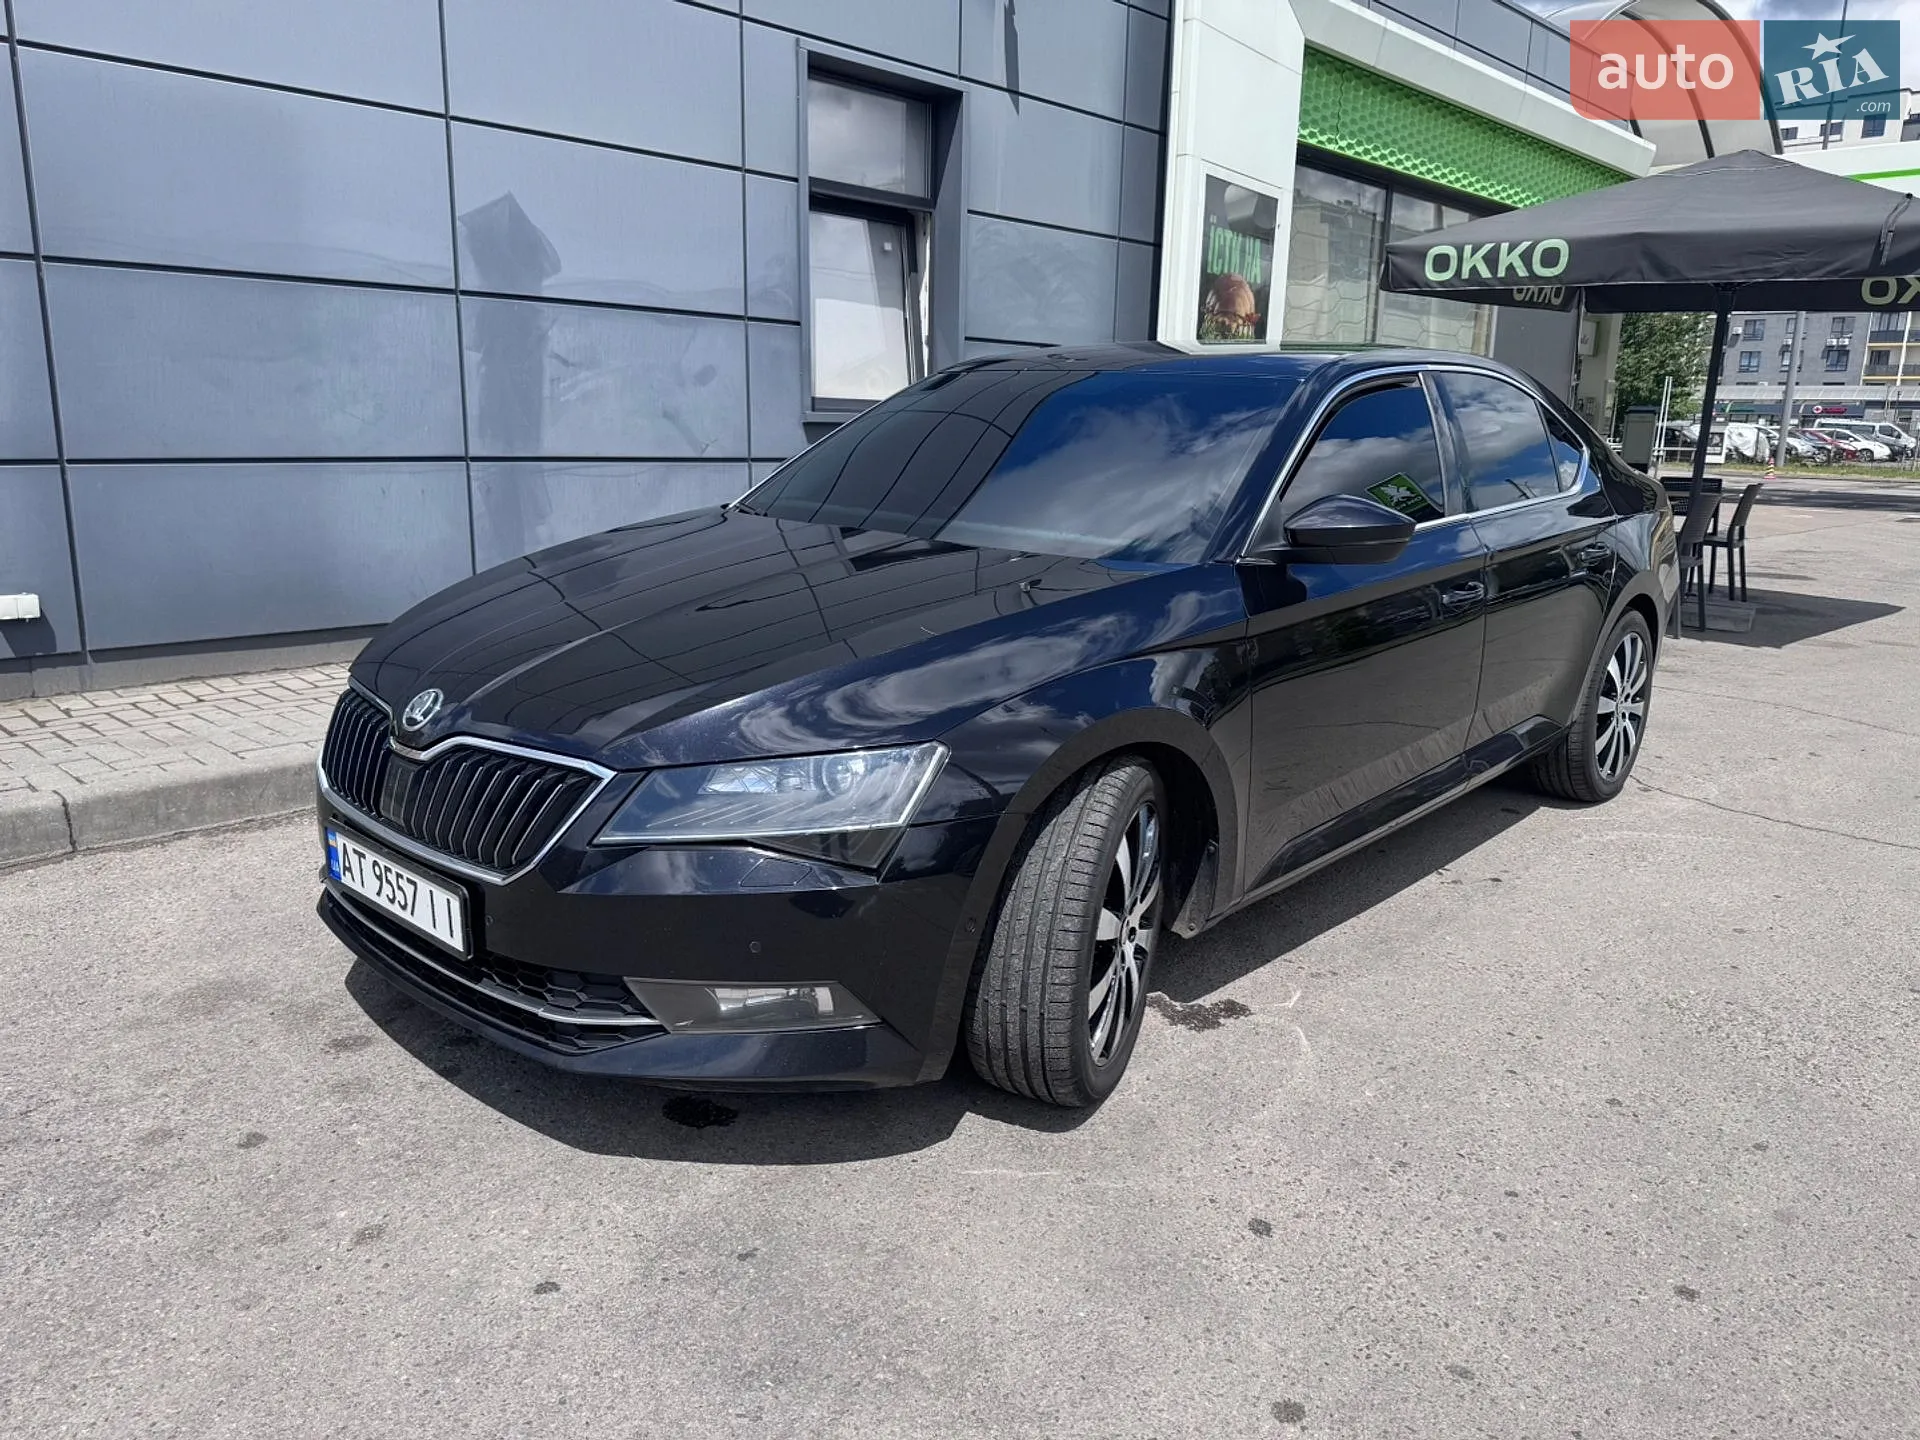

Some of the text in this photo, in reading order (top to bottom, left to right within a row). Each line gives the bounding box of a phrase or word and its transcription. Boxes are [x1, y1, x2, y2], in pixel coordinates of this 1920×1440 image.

[1424, 238, 1570, 282] OKKO
[342, 842, 367, 889] AT
[372, 860, 418, 917] 9557
